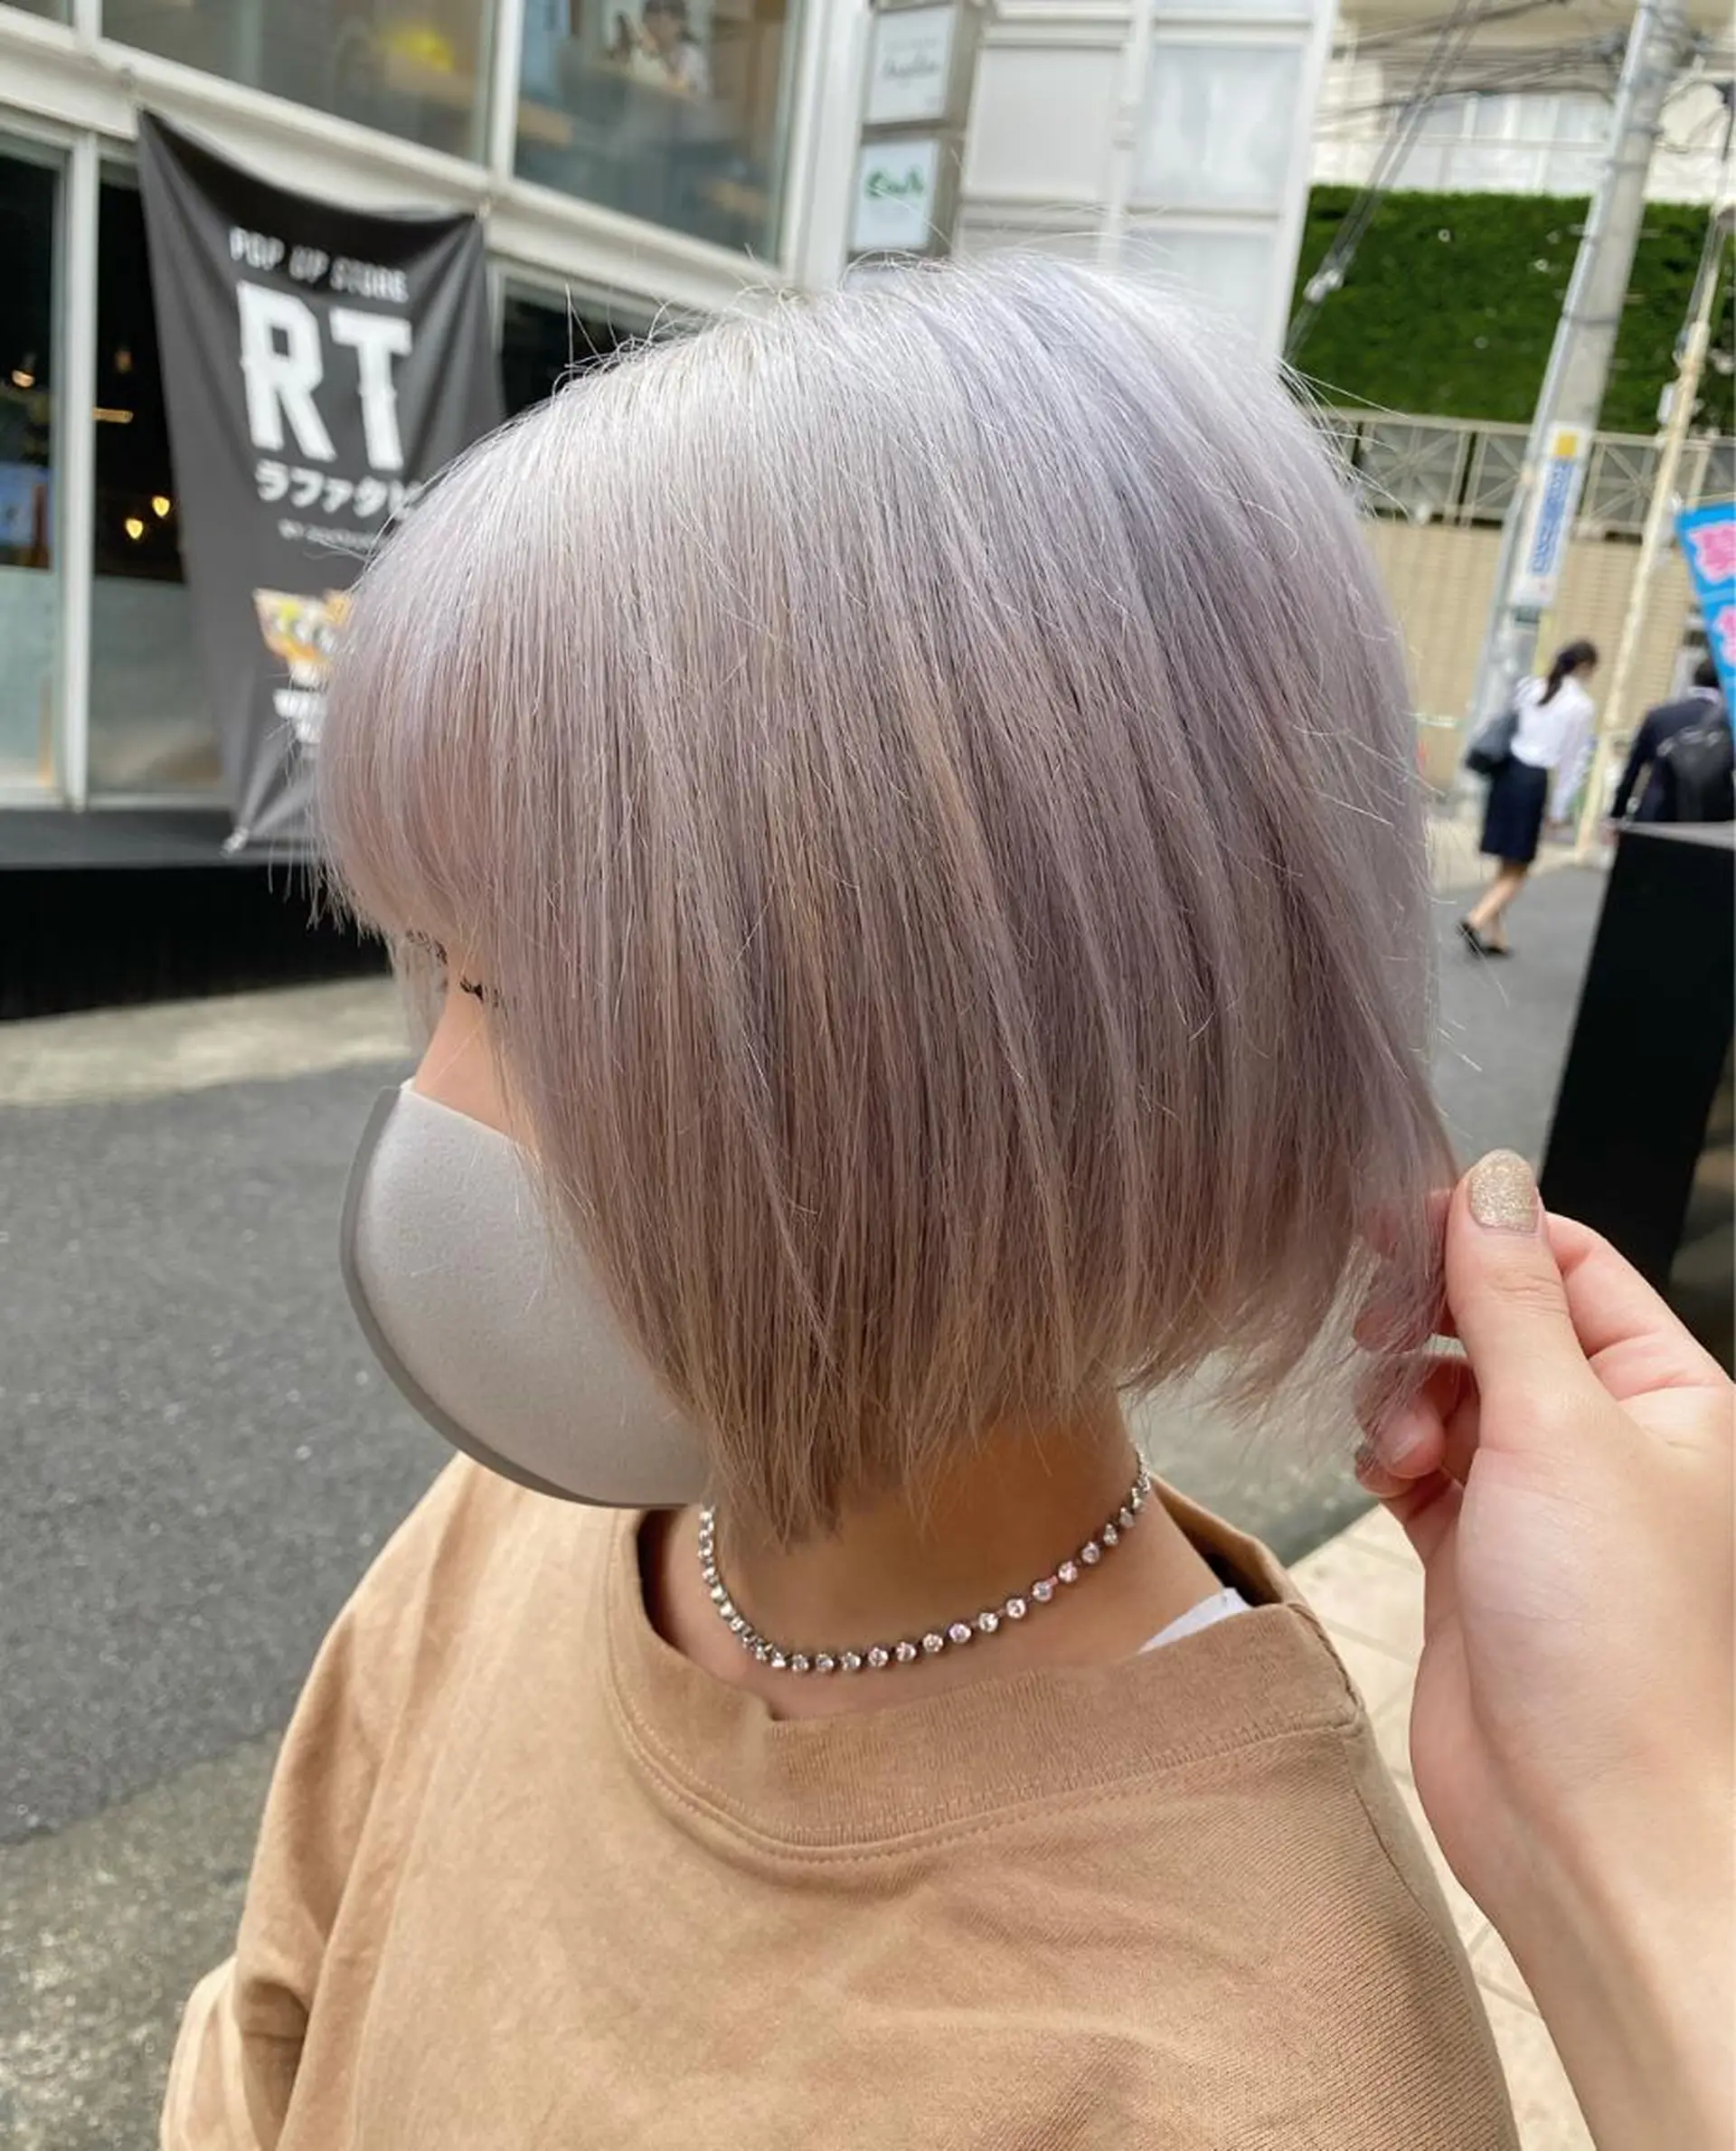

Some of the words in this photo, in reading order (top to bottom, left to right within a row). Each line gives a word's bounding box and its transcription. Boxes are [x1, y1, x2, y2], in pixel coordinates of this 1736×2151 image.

[230, 226, 285, 270] POP
[288, 245, 329, 283] UP
[330, 257, 408, 303] STORE
[236, 279, 412, 470] RT
